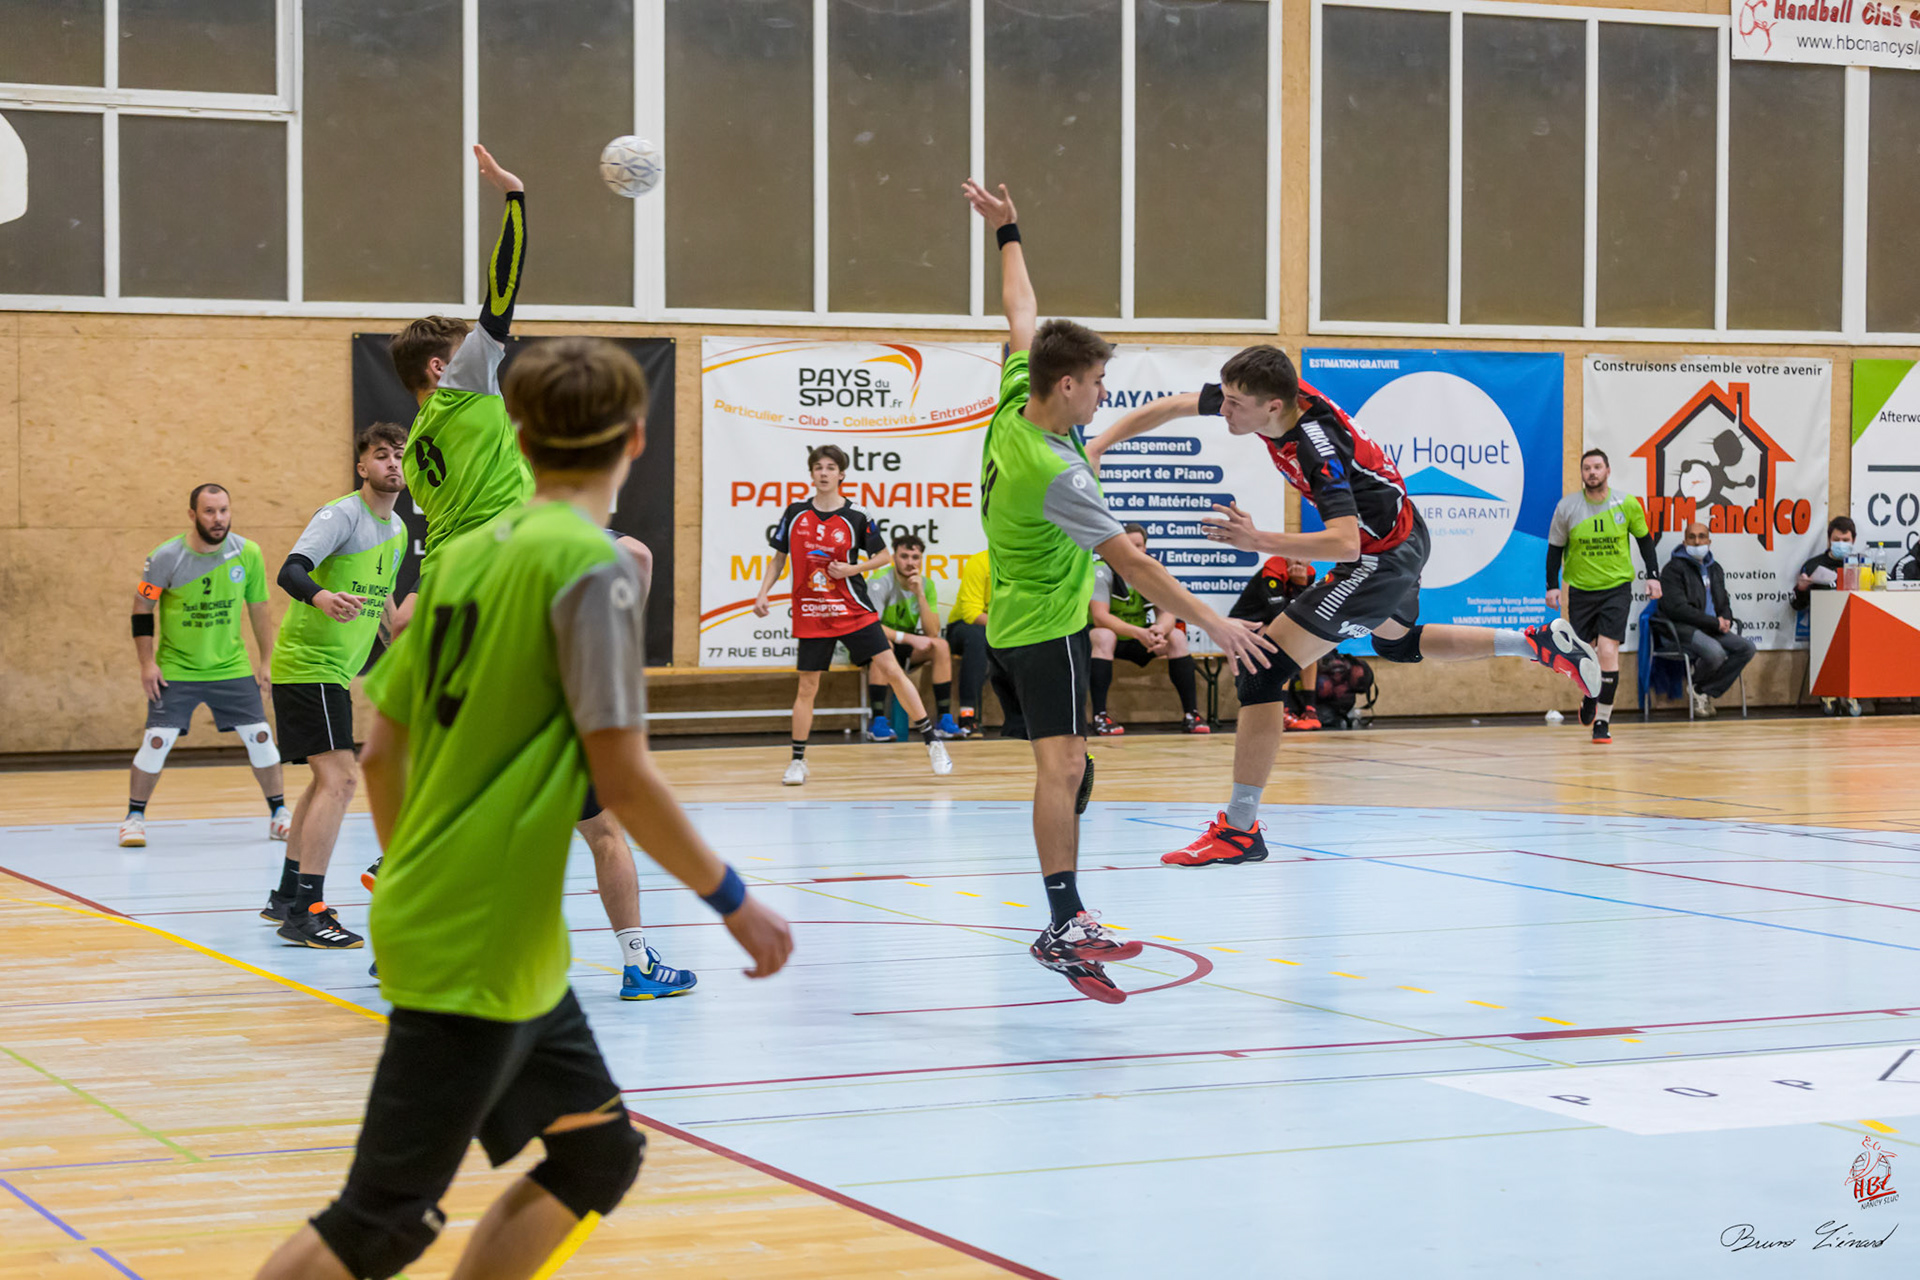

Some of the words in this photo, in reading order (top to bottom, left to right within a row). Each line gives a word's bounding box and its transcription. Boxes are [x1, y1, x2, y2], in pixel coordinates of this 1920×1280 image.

[1774, 0, 1853, 23] Handball
[1797, 33, 1920, 58] www.hbcnancysl
[1309, 358, 1358, 369] ESTIMATION
[1359, 359, 1400, 370] GRATUITE
[1593, 360, 1677, 373] Construisons
[1680, 362, 1742, 374] ensemble
[1746, 363, 1780, 375] votre
[1783, 364, 1823, 376] avenir
[799, 367, 871, 388] PAYS
[874, 378, 890, 389] du
[713, 398, 785, 423] Particulier
[798, 414, 829, 427] Club
[842, 412, 917, 428] Collectivité
[929, 396, 995, 422] Entreprise
[1413, 437, 1511, 470] Hoquet
[1154, 467, 1171, 480] de
[1174, 467, 1215, 481] Piano
[731, 481, 973, 507] PARENAIRE
[1127, 495, 1145, 508] de
[1148, 494, 1212, 508] Matériels
[1447, 507, 1510, 519] GARANTI
[1709, 498, 1767, 534] and
[816, 523, 826, 542] 5
[1147, 522, 1164, 535] de
[1593, 519, 1604, 533] 11
[375, 554, 383, 575] 4
[1166, 550, 1237, 566] Entreprise
[143, 585, 153, 598] C
[202, 577, 212, 595] 2
[351, 580, 368, 594] Taxi
[1735, 592, 1753, 601] vos
[1519, 615, 1546, 625] NANCY
[707, 646, 724, 658] 77
[728, 646, 758, 658] RUE
